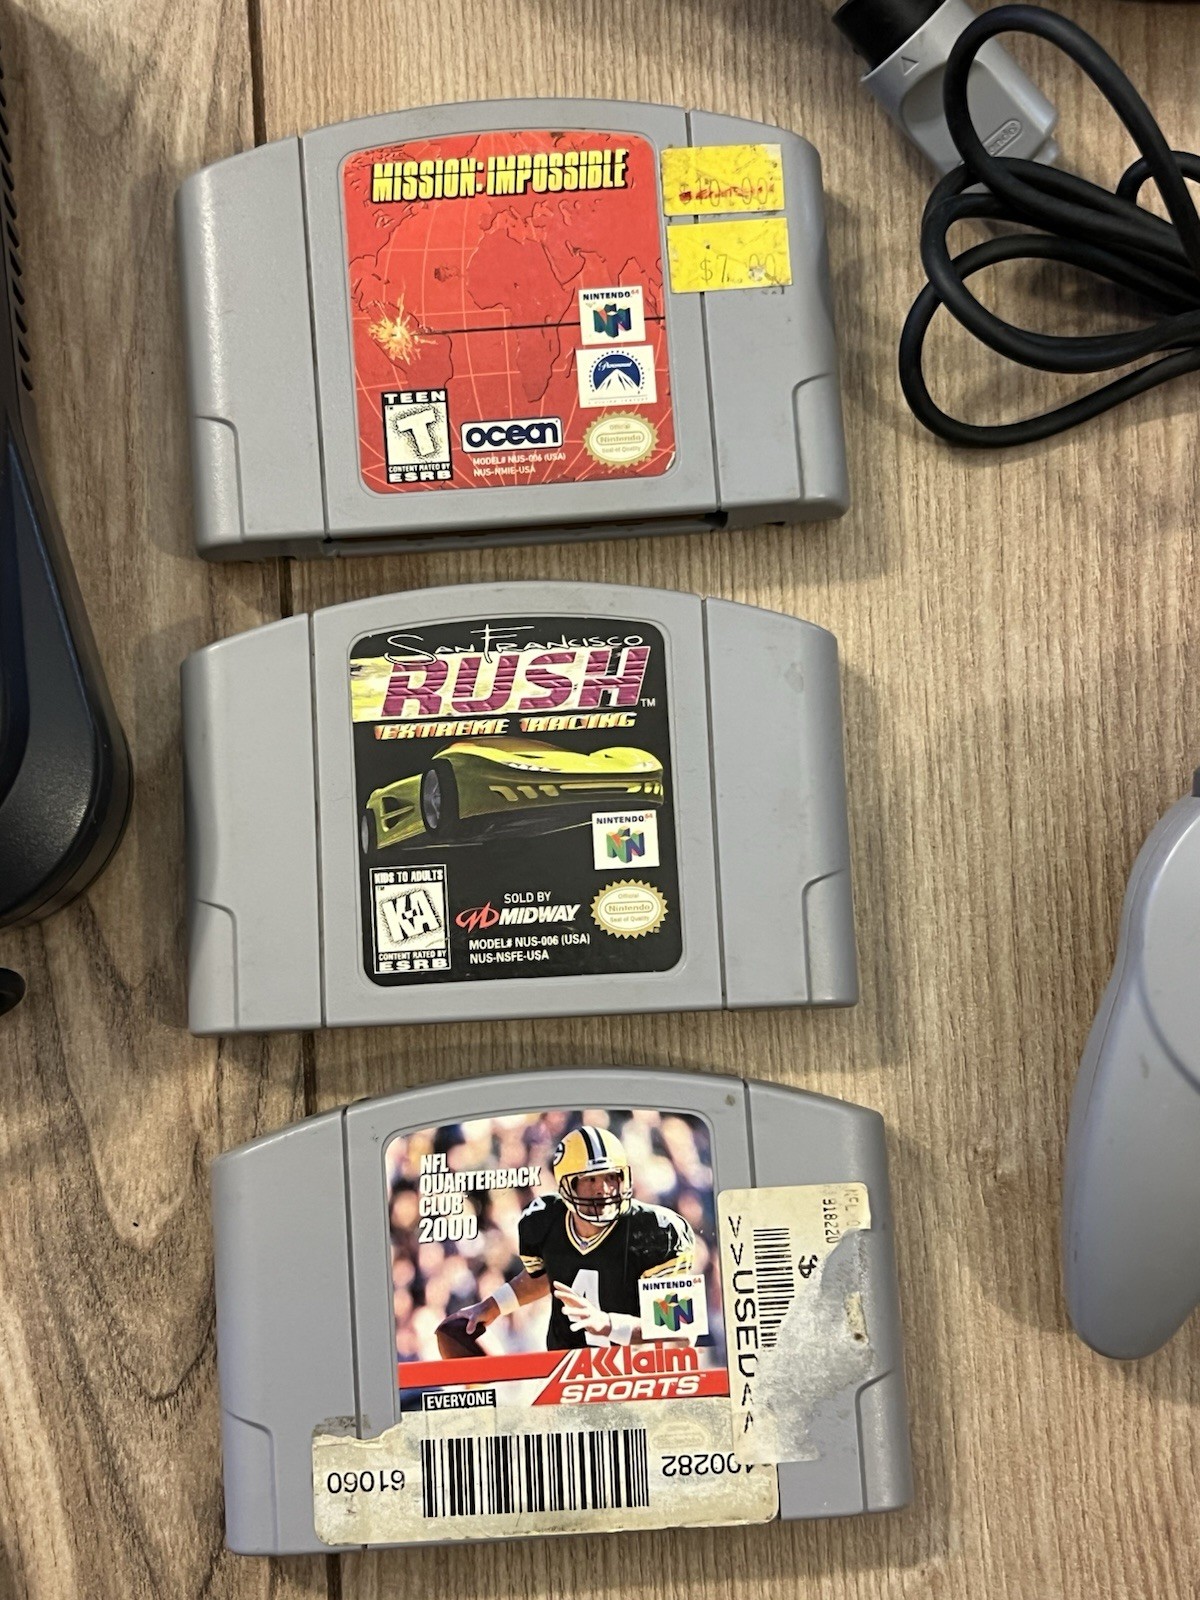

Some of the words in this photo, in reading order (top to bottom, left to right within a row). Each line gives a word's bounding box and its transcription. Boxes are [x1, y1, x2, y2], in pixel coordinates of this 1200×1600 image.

[372, 158, 485, 203] MISSION:
[486, 148, 629, 196] IMPOSSIBLE
[583, 291, 631, 301] NINTENDO
[384, 391, 446, 405] TEEN
[396, 408, 437, 456] T
[466, 422, 559, 448] ocean
[473, 456, 506, 466] MODEL#
[508, 454, 542, 464] NUS-006
[544, 453, 566, 462] (USA)
[388, 464, 418, 473] CONTENT
[388, 470, 452, 483] ESRB
[473, 466, 536, 477] NUS-NMIE-USA
[380, 646, 651, 718] RUSH
[374, 718, 510, 740] EXTREME
[519, 712, 637, 733] RACING
[596, 815, 644, 824] NINTENDO
[374, 872, 394, 884] KIDS
[396, 871, 408, 883] TO
[411, 869, 443, 882] ADULTS
[504, 892, 534, 904] SOLD
[537, 891, 552, 903] BY
[499, 904, 581, 925] MIDWAY
[608, 903, 650, 912] Nintendo
[469, 938, 513, 950] MODEL#
[515, 935, 559, 948] NUS-006
[561, 933, 591, 946] (USA)
[379, 952, 411, 961] CONTENT
[413, 950, 436, 959] RATED
[437, 949, 447, 957] BY
[469, 949, 550, 964] NUS-NSFE-USA
[379, 958, 448, 971] ESRB
[420, 1153, 449, 1175] NFL
[420, 1166, 541, 1197] QUARTERBACK
[419, 1192, 464, 1217] CLUB
[418, 1215, 479, 1244] 2000
[642, 1280, 692, 1290] NINTENDO
[560, 1375, 701, 1404] SPORTS
[426, 1391, 494, 1410] EVERYONE
[661, 1453, 754, 1477] 00282
[327, 1469, 405, 1494] 61060
